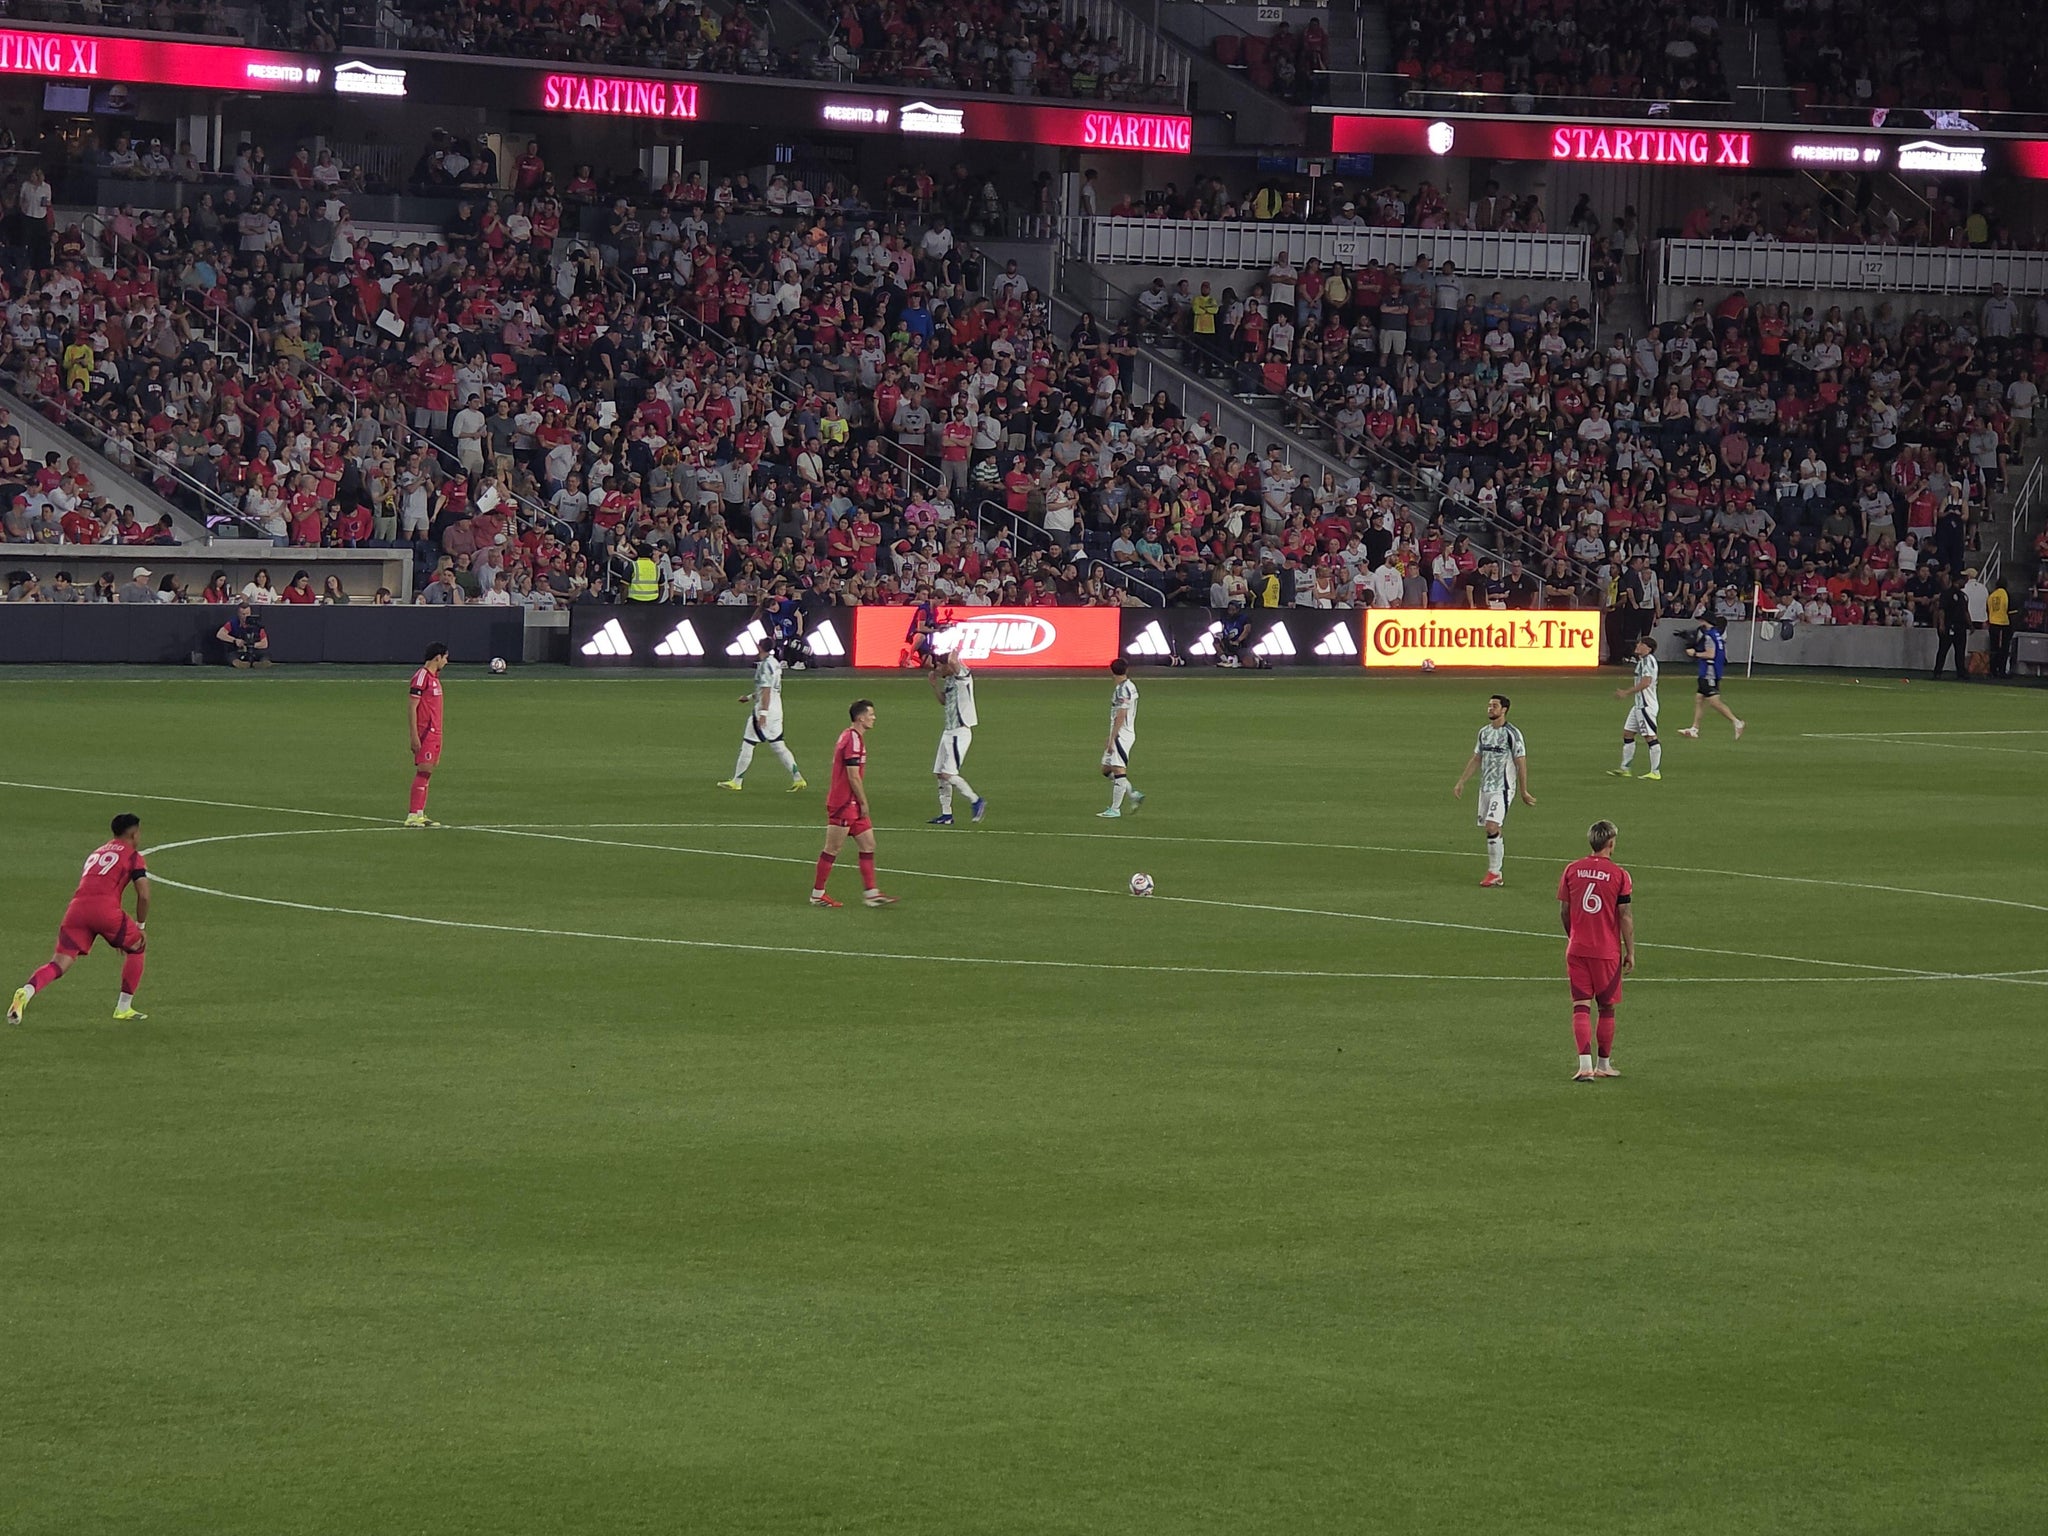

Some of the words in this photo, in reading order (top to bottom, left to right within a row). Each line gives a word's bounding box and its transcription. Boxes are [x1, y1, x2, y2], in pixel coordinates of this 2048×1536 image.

[1260, 9, 1280, 19] 226
[67, 39, 98, 74] XI
[246, 64, 303, 82] PRESENTED
[306, 67, 321, 83] BY
[545, 75, 666, 116] STARTING
[670, 84, 699, 118] XI
[823, 105, 874, 123] PRESENTED
[876, 108, 889, 124] BY
[1084, 113, 1190, 150] STARTING
[1553, 127, 1709, 164] STARTING
[1714, 133, 1751, 165] XI
[1791, 145, 1860, 162] PRESENTED
[1863, 147, 1881, 163] BY
[1338, 243, 1356, 253] 127
[1865, 262, 1883, 272] 127
[1373, 618, 1517, 656] Continental
[1538, 619, 1594, 649] Tire
[1490, 800, 1498, 811] 8
[82, 852, 119, 877] 99
[1577, 869, 1610, 881] WALLEM
[1583, 882, 1602, 914] 6
